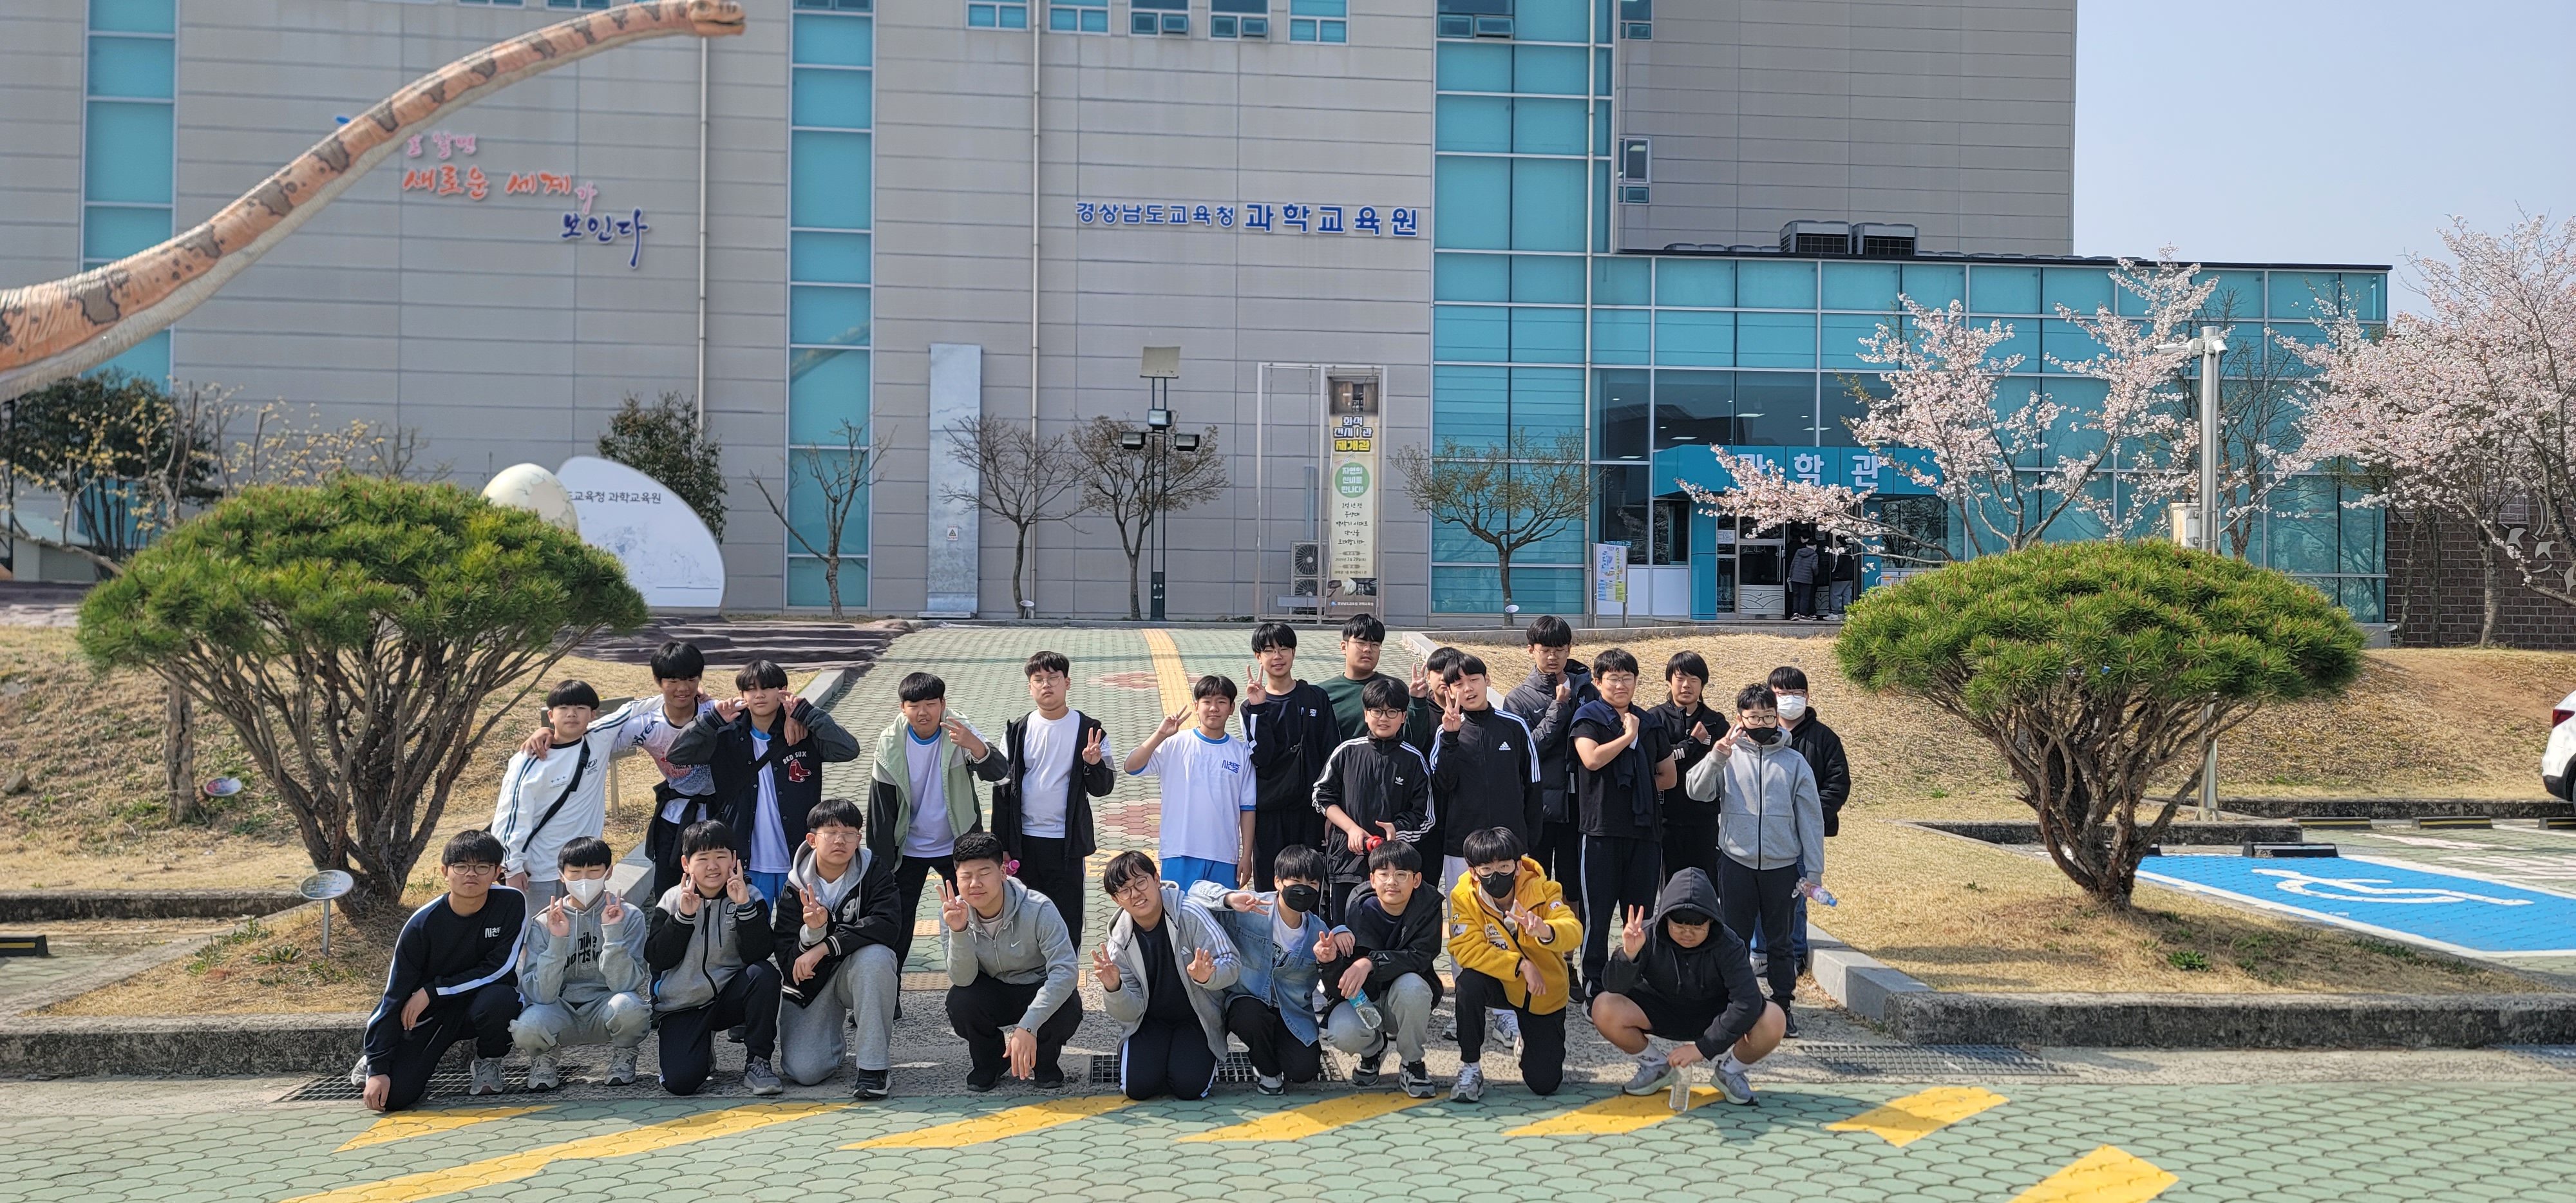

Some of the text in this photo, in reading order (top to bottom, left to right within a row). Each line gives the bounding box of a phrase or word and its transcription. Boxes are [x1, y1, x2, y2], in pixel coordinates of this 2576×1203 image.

[402, 164, 598, 214] 새로운 세계가
[1076, 202, 1418, 236] 경상남도교육청 과학교육원
[561, 207, 649, 269] 보인다
[1343, 416, 1363, 426] 화석
[1336, 440, 1370, 451] 재개관
[608, 492, 661, 504] 과학교육원
[782, 754, 794, 764] RED
[1221, 759, 1240, 773] 사천중
[575, 931, 598, 951] nike
